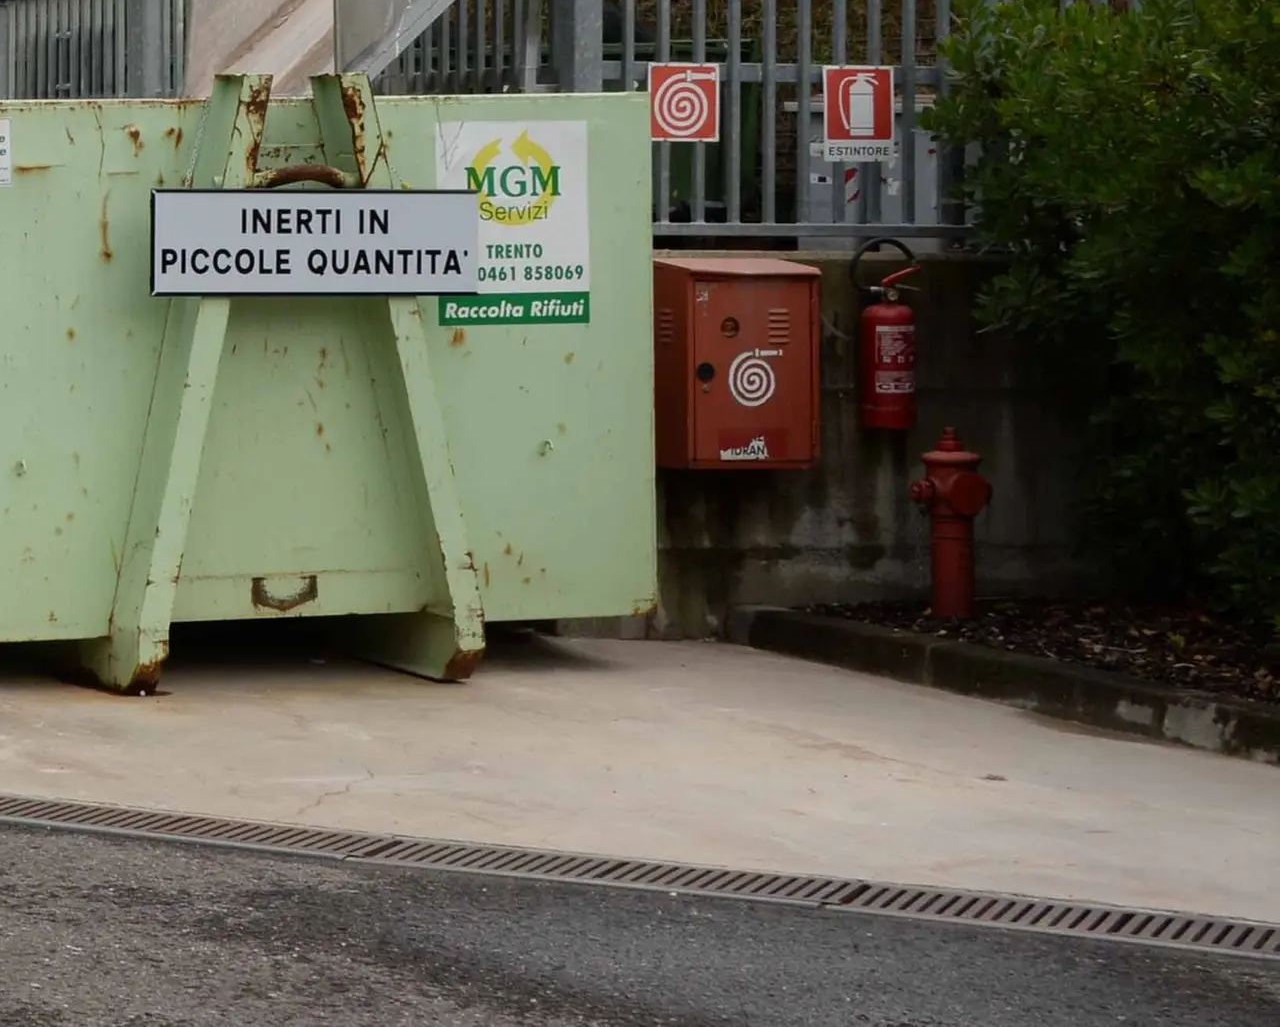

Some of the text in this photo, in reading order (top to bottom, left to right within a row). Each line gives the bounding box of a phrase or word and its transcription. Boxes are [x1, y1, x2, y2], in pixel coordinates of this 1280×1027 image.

[828, 146, 890, 156] ESTINTORE
[464, 165, 562, 197] MGM
[241, 208, 389, 234] INERTI IN
[479, 201, 549, 221] Servizi
[486, 243, 543, 259] TRENTO
[161, 249, 469, 276] PICCOLE QUANTITA'
[477, 264, 584, 281] 0461 858069
[445, 298, 585, 318] Raccolta Rifiuti
